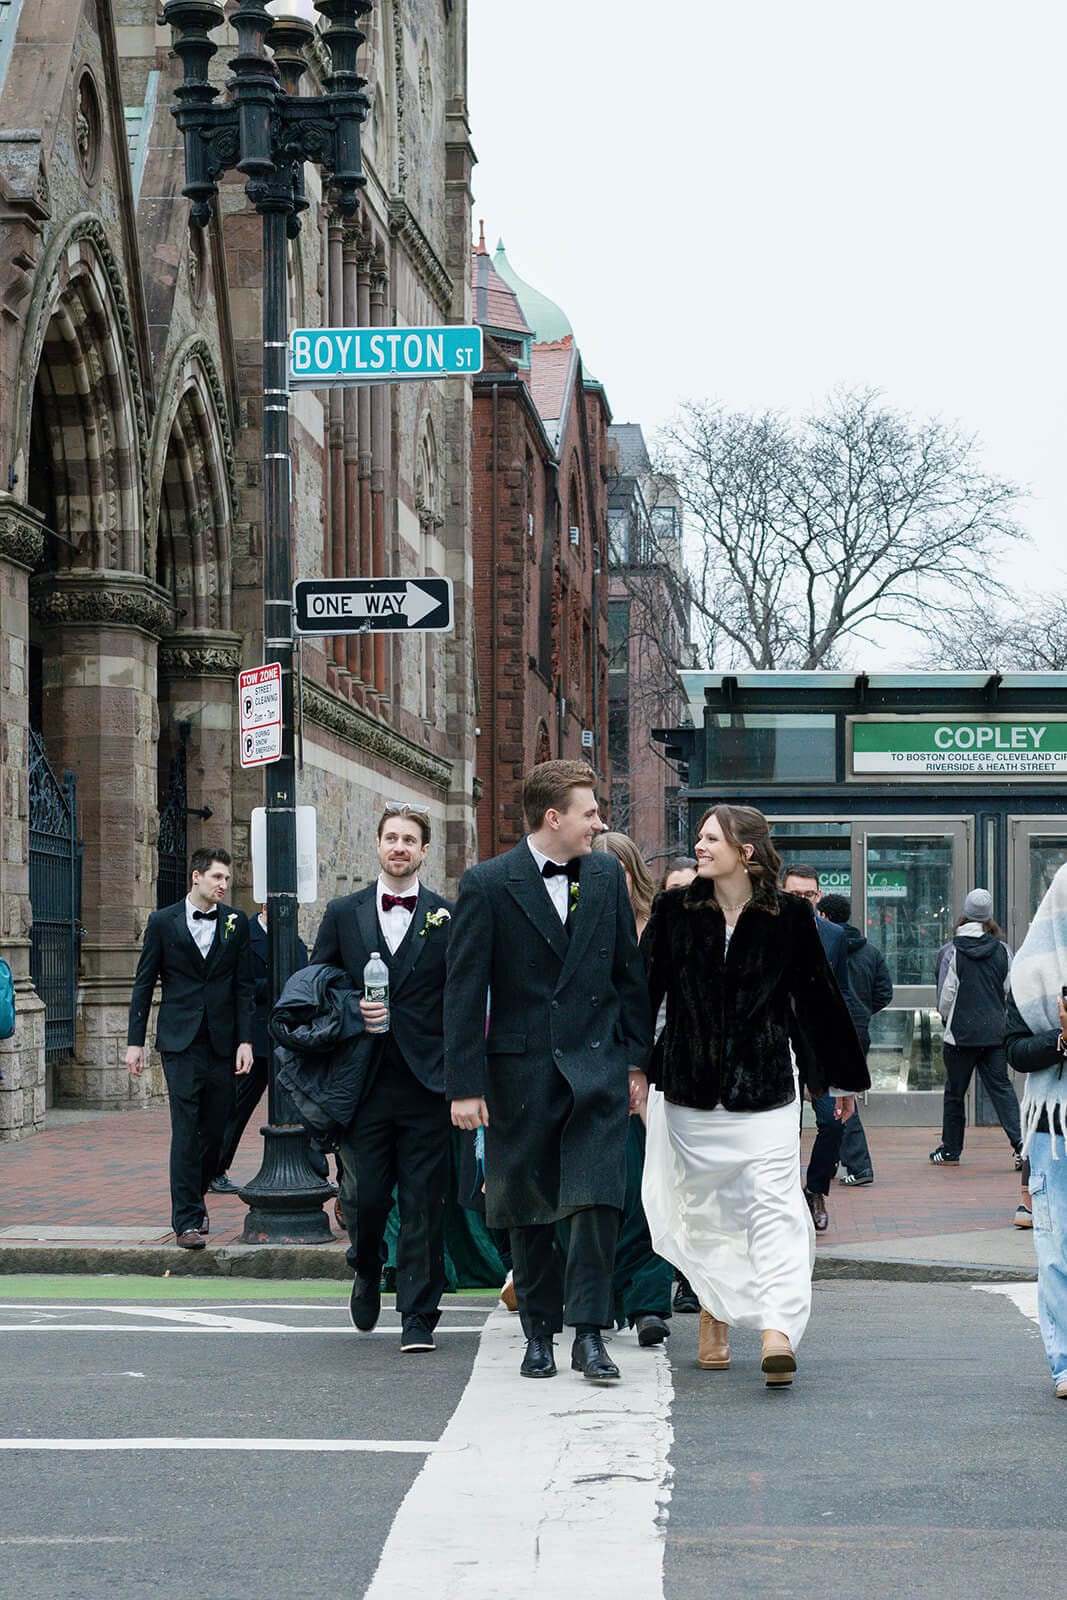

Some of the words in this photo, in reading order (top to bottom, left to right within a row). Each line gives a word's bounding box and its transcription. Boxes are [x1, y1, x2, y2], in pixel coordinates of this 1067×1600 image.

[296, 334, 444, 369] BOYLSTON
[455, 348, 473, 367] ST
[313, 596, 352, 615] ONE
[365, 595, 407, 614] WAY
[242, 672, 258, 686] TOW
[260, 667, 279, 681] ZONE
[255, 684, 272, 695] STREET
[255, 693, 278, 706] CLEANING
[255, 729, 270, 738] DURING
[934, 727, 1047, 749] COPLEY
[255, 737, 267, 745] SNOW
[255, 744, 277, 754] EMERGENCY
[891, 753, 904, 761] TO
[906, 753, 945, 761] BOSTON
[947, 753, 994, 762] COLLEGE,
[996, 753, 1051, 761] CLEVELAND
[819, 873, 877, 885] COPY
